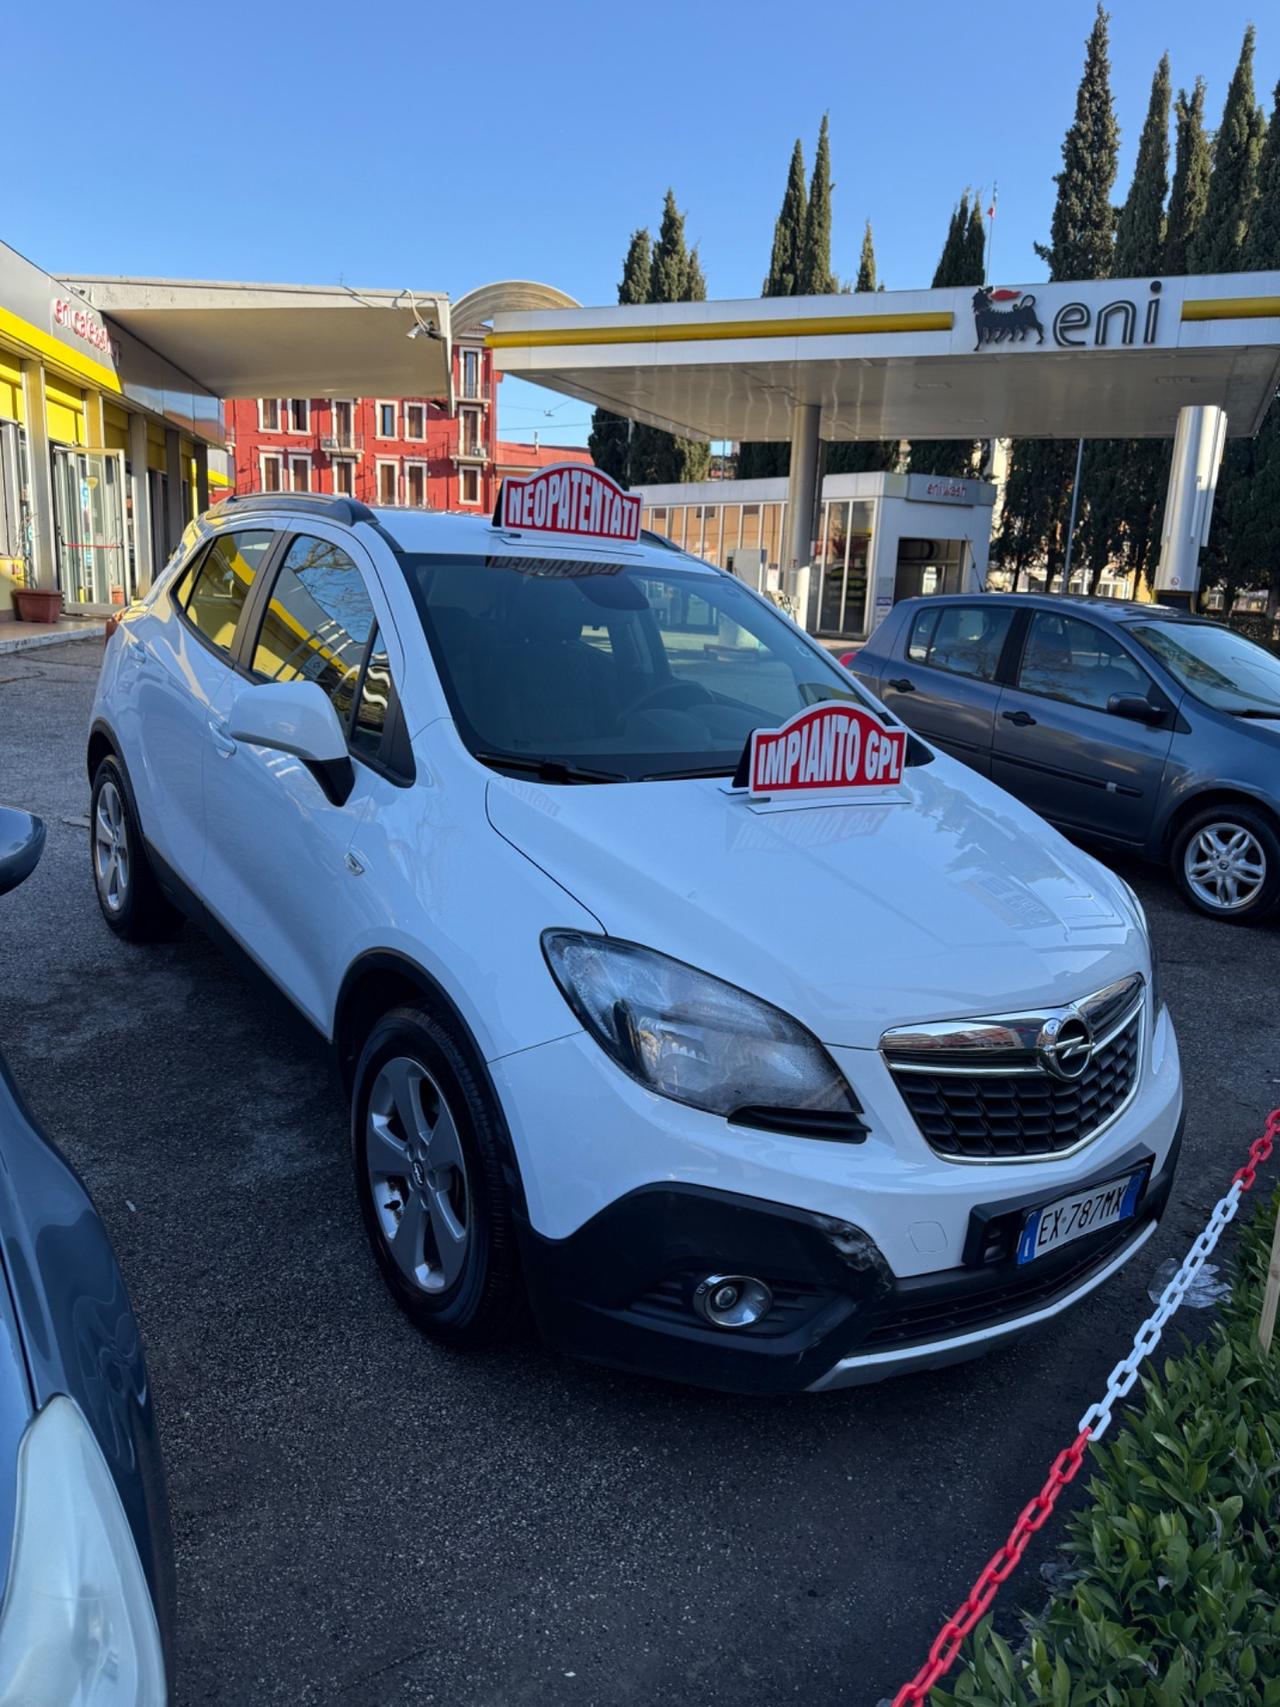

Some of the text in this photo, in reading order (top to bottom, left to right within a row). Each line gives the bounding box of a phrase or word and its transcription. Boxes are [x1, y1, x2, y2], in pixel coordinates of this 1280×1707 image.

[1053, 281, 1163, 346] eni
[508, 469, 639, 538] NEOPATENTATI
[757, 713, 900, 786] IMPIANTO GPL
